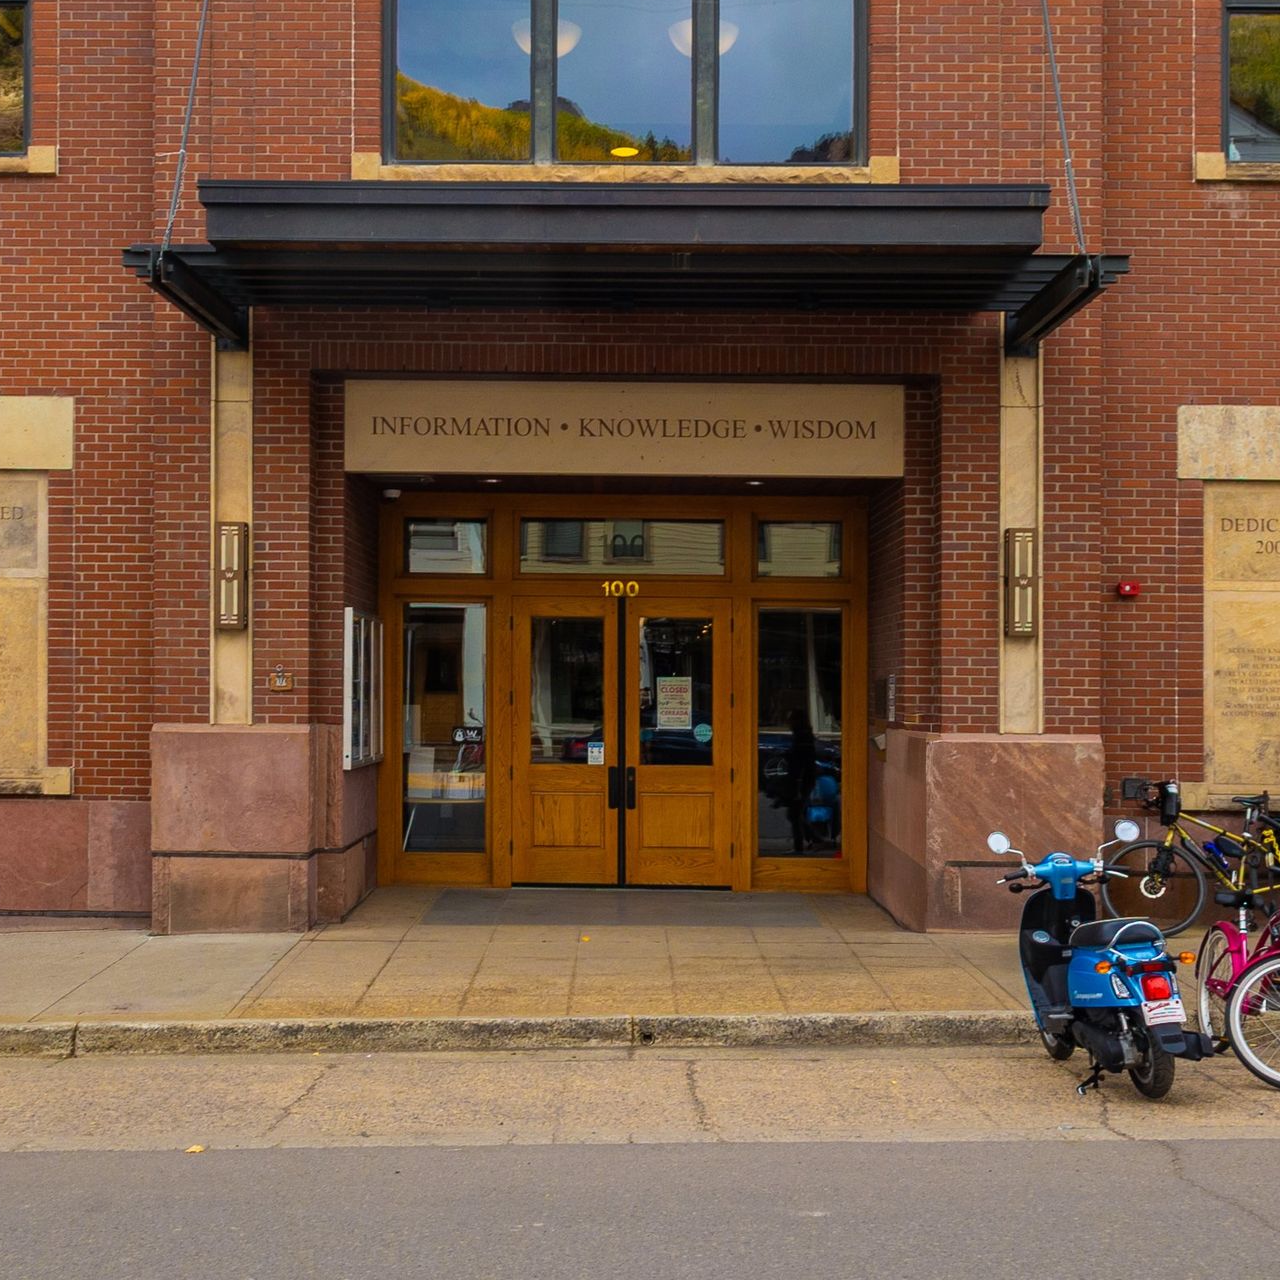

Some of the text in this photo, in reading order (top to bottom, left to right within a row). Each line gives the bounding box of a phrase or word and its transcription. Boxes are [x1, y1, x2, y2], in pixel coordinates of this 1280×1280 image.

[371, 416, 877, 440] INFORMATION KNOWLEDGE WISDOM
[601, 580, 640, 597] 100
